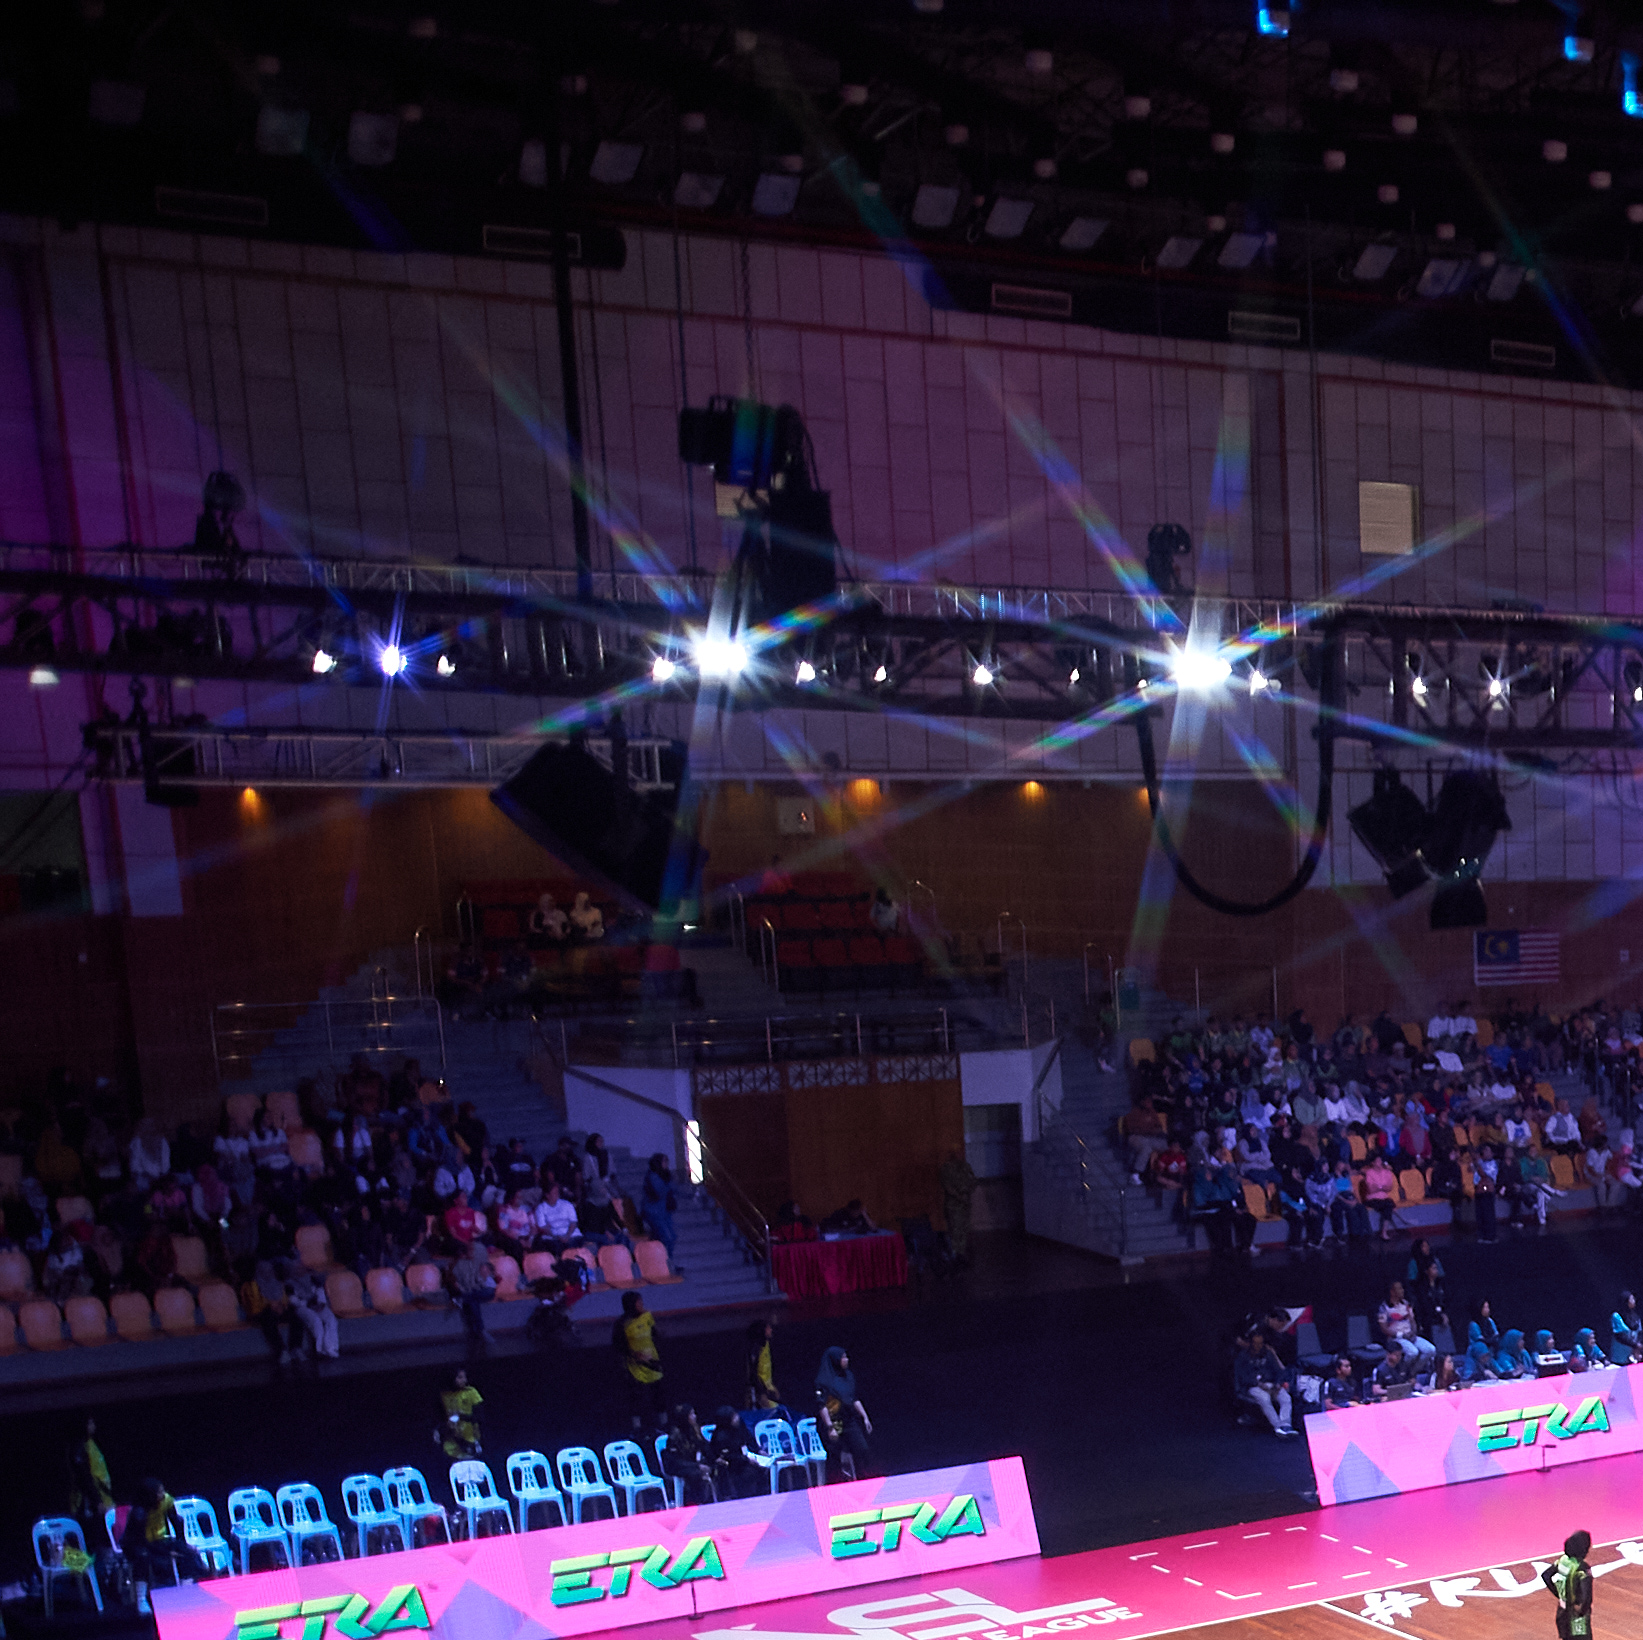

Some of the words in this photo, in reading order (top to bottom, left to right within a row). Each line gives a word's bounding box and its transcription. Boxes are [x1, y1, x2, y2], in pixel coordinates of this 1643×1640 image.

[1476, 1396, 1610, 1452] ERA
[830, 1493, 985, 1560] ERA
[549, 1535, 728, 1608] ERA
